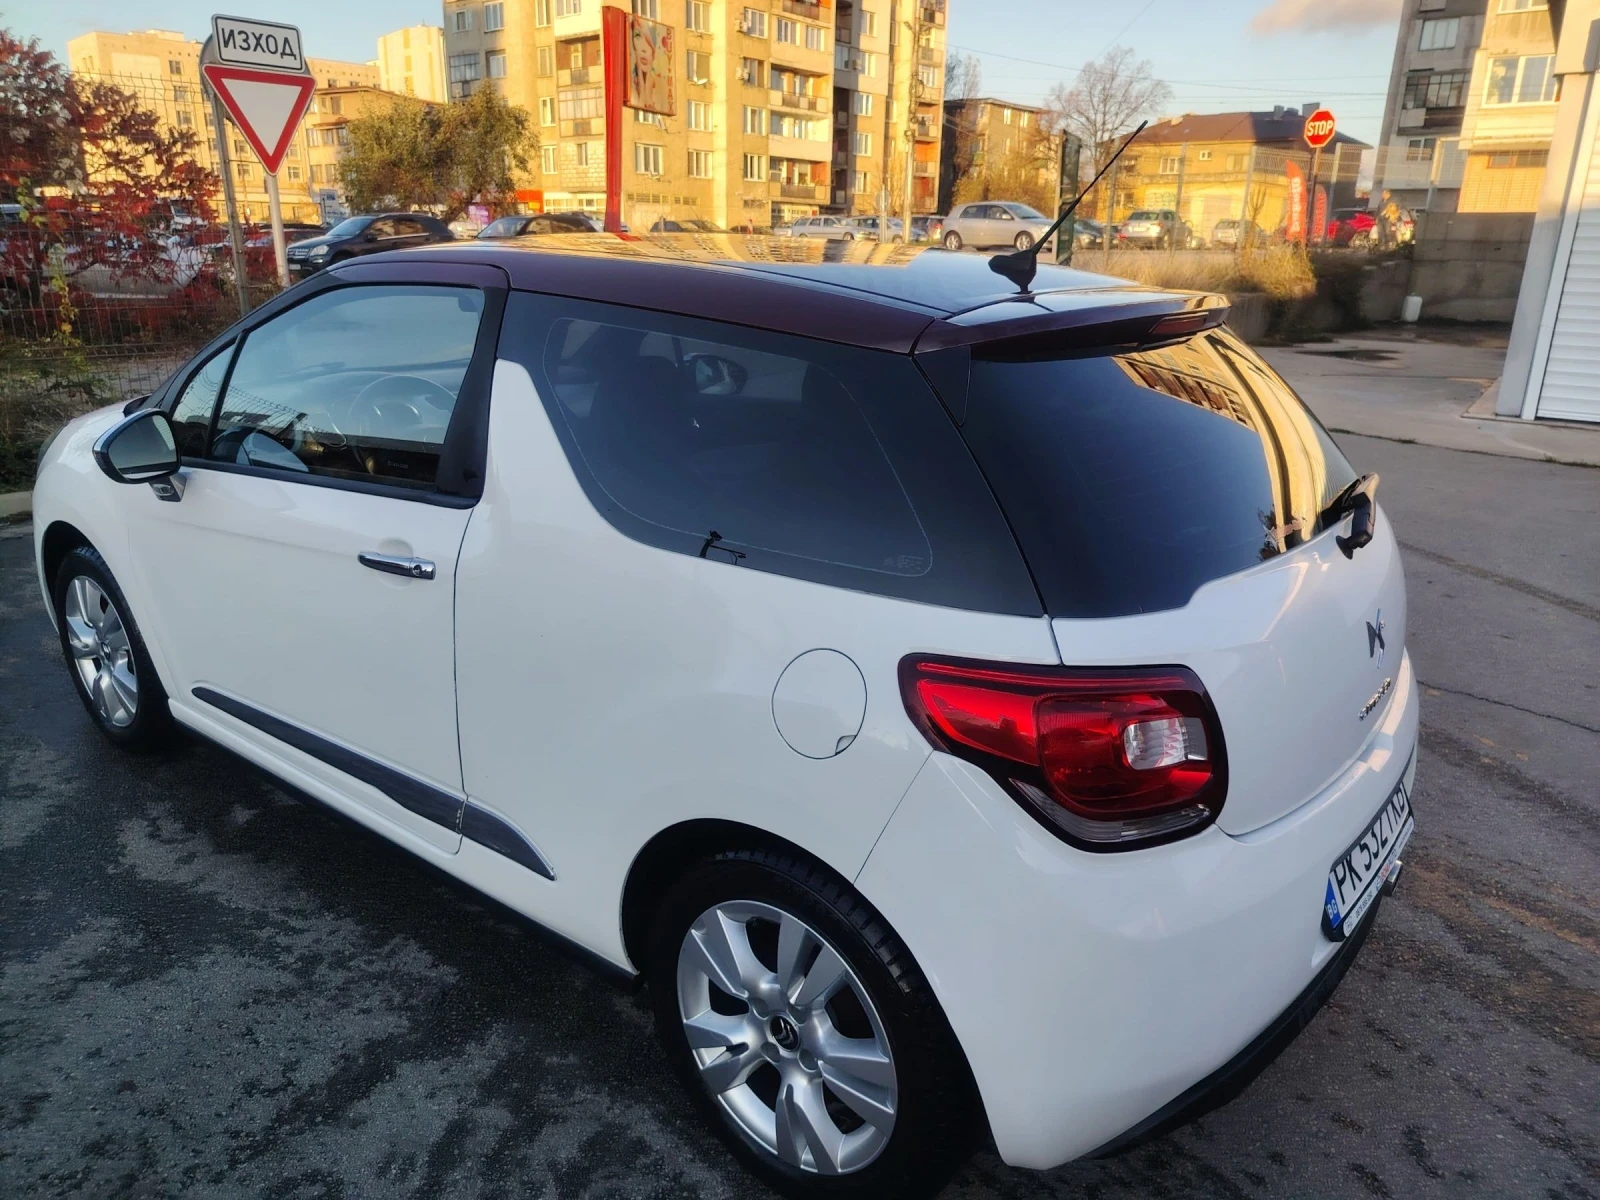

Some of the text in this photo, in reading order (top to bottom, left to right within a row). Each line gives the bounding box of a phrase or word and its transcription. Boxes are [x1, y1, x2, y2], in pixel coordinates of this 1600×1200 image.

[221, 27, 297, 60] ИЗХОД
[1307, 119, 1334, 136] STOP
[1327, 898, 1338, 920] BG
